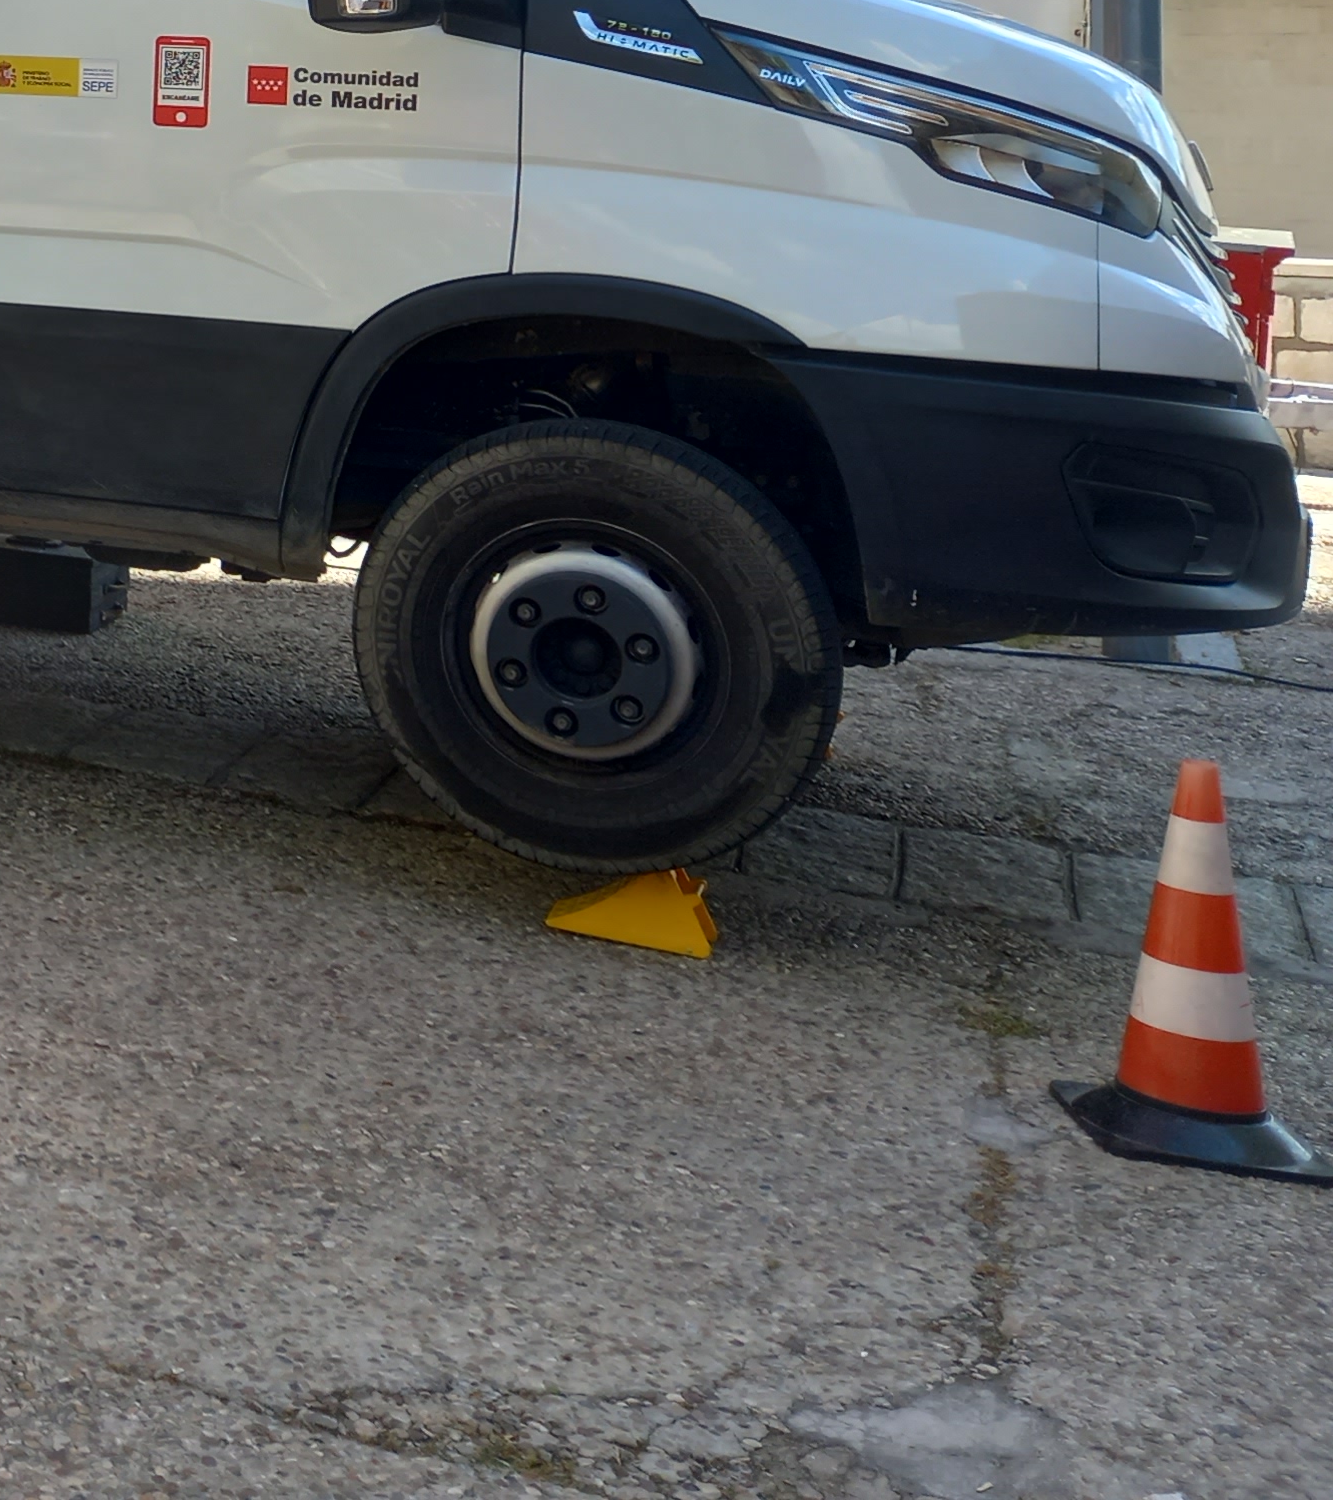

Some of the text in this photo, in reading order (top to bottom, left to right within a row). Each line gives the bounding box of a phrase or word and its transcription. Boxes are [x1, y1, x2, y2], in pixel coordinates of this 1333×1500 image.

[82, 80, 114, 93] SEPE
[293, 67, 419, 88] Comunidad
[759, 68, 806, 88] DAILY
[292, 89, 418, 112] de Madrid
[449, 470, 505, 505] Rain
[509, 461, 566, 481] Max
